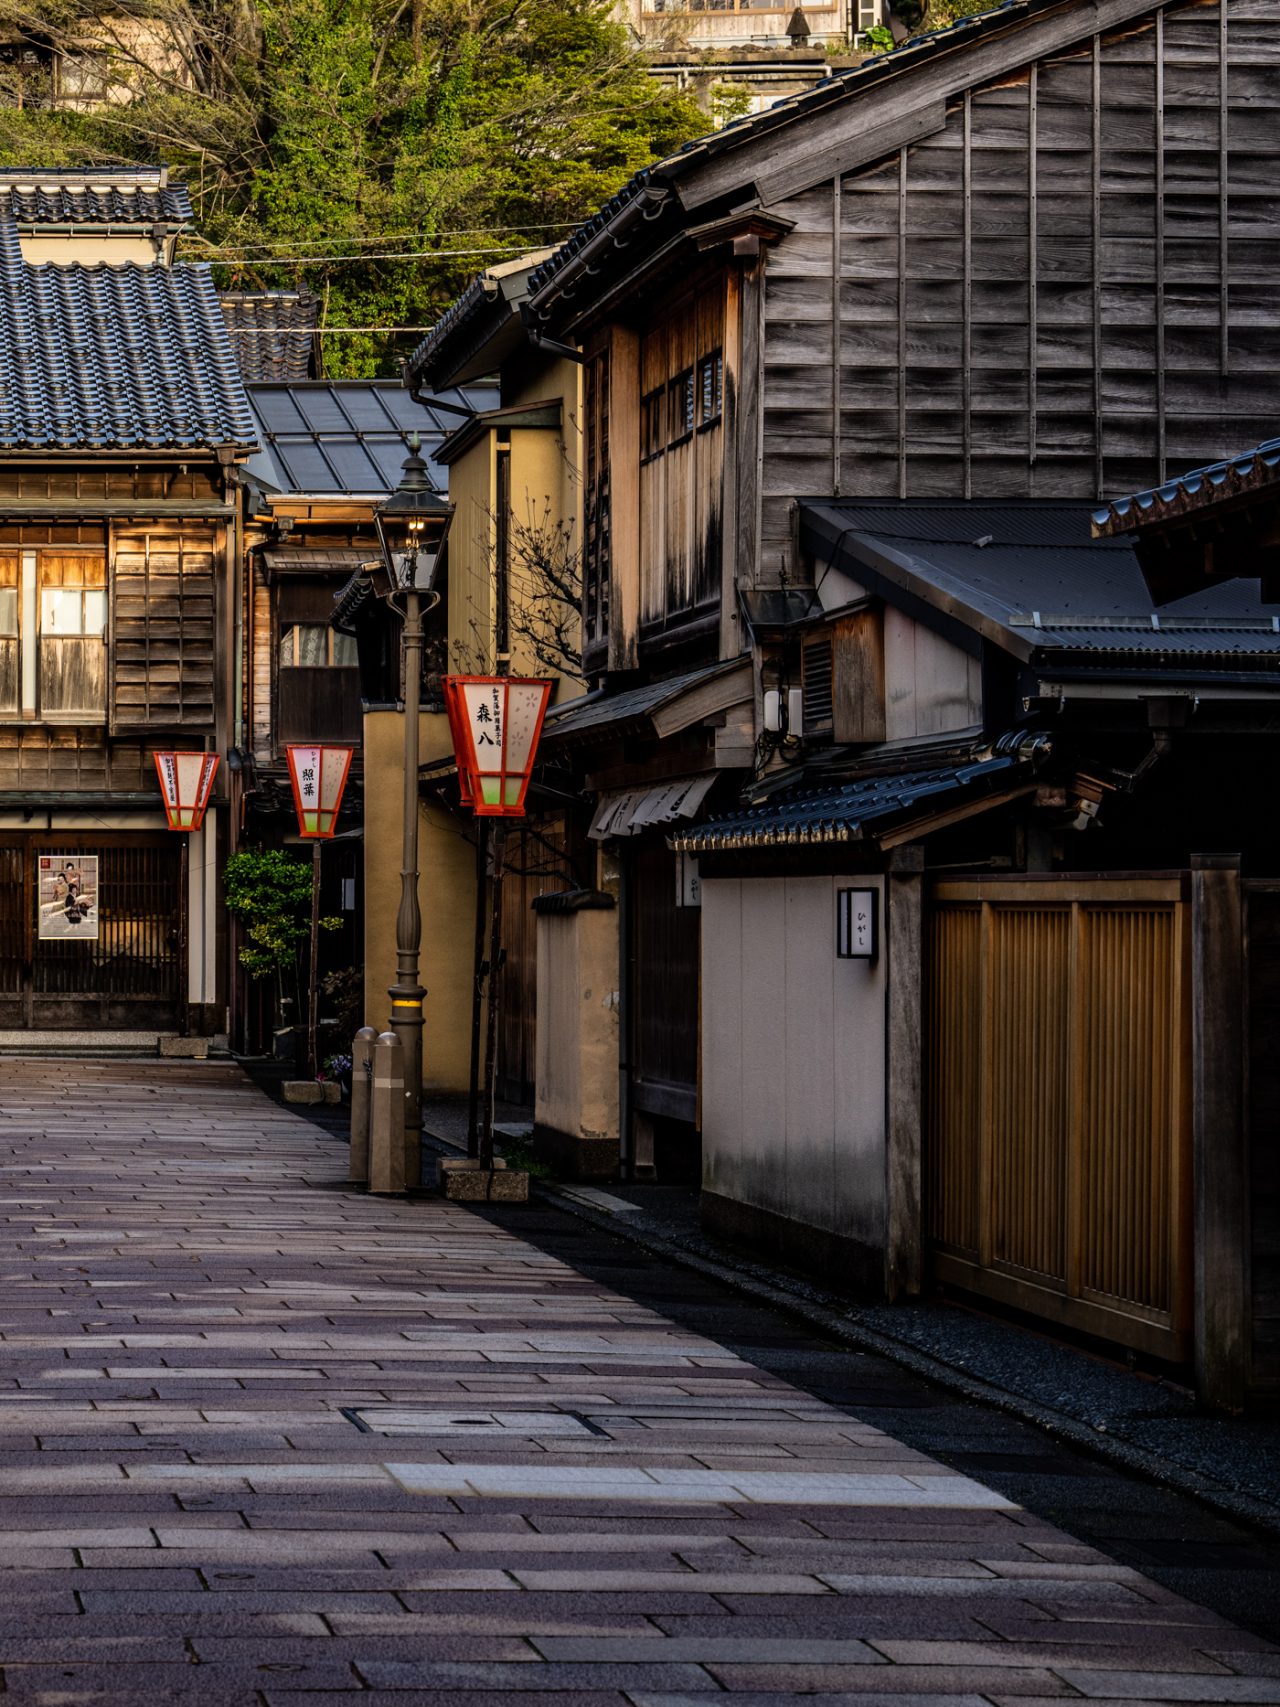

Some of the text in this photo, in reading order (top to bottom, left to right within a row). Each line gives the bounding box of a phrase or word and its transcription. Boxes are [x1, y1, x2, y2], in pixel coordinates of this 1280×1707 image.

[477, 703, 495, 745] 森八
[302, 768, 315, 797] 照葉
[857, 912, 866, 945] ひがし
